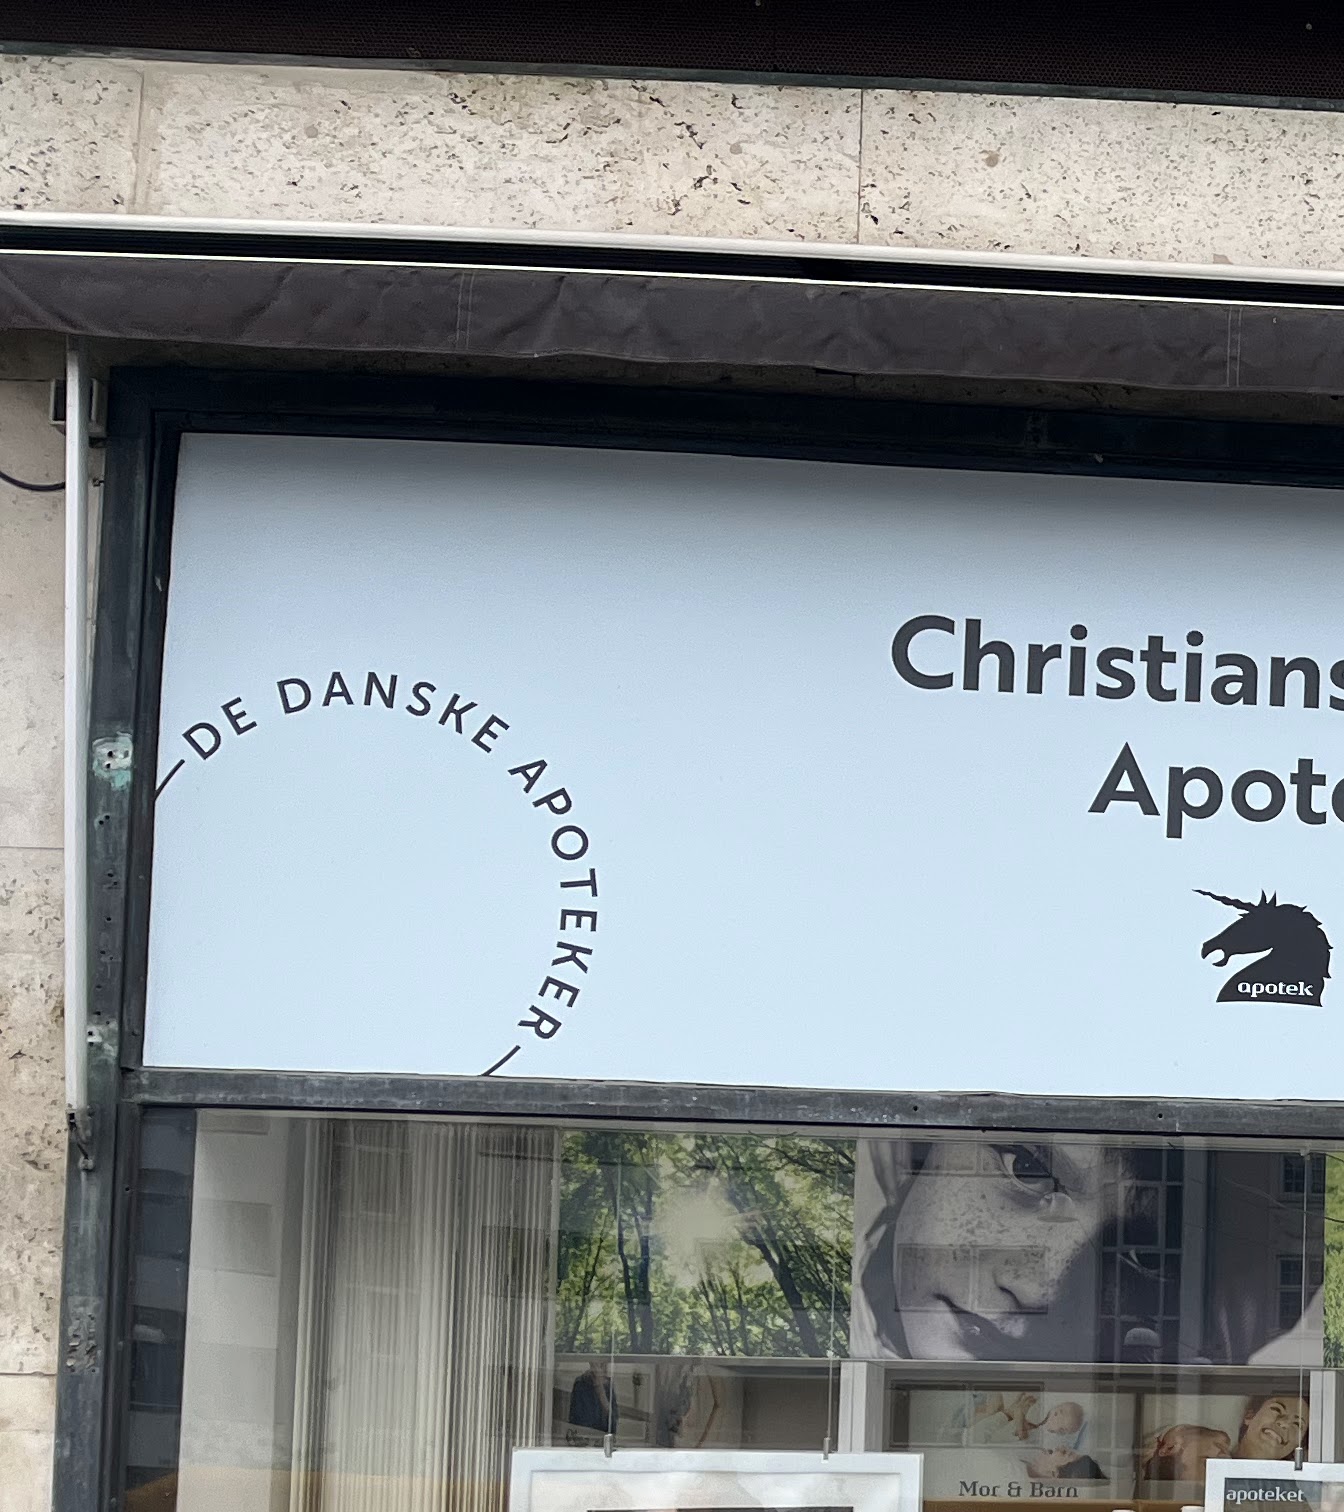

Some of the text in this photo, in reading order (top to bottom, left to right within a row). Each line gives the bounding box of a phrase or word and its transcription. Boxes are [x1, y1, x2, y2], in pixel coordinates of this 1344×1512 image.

[182, 671, 599, 1041] DE DANSKE APOTEKER
[1237, 977, 1314, 999] apotek
[959, 1481, 1078, 1498] Mor & Barn
[1226, 1485, 1305, 1506] apoteket
